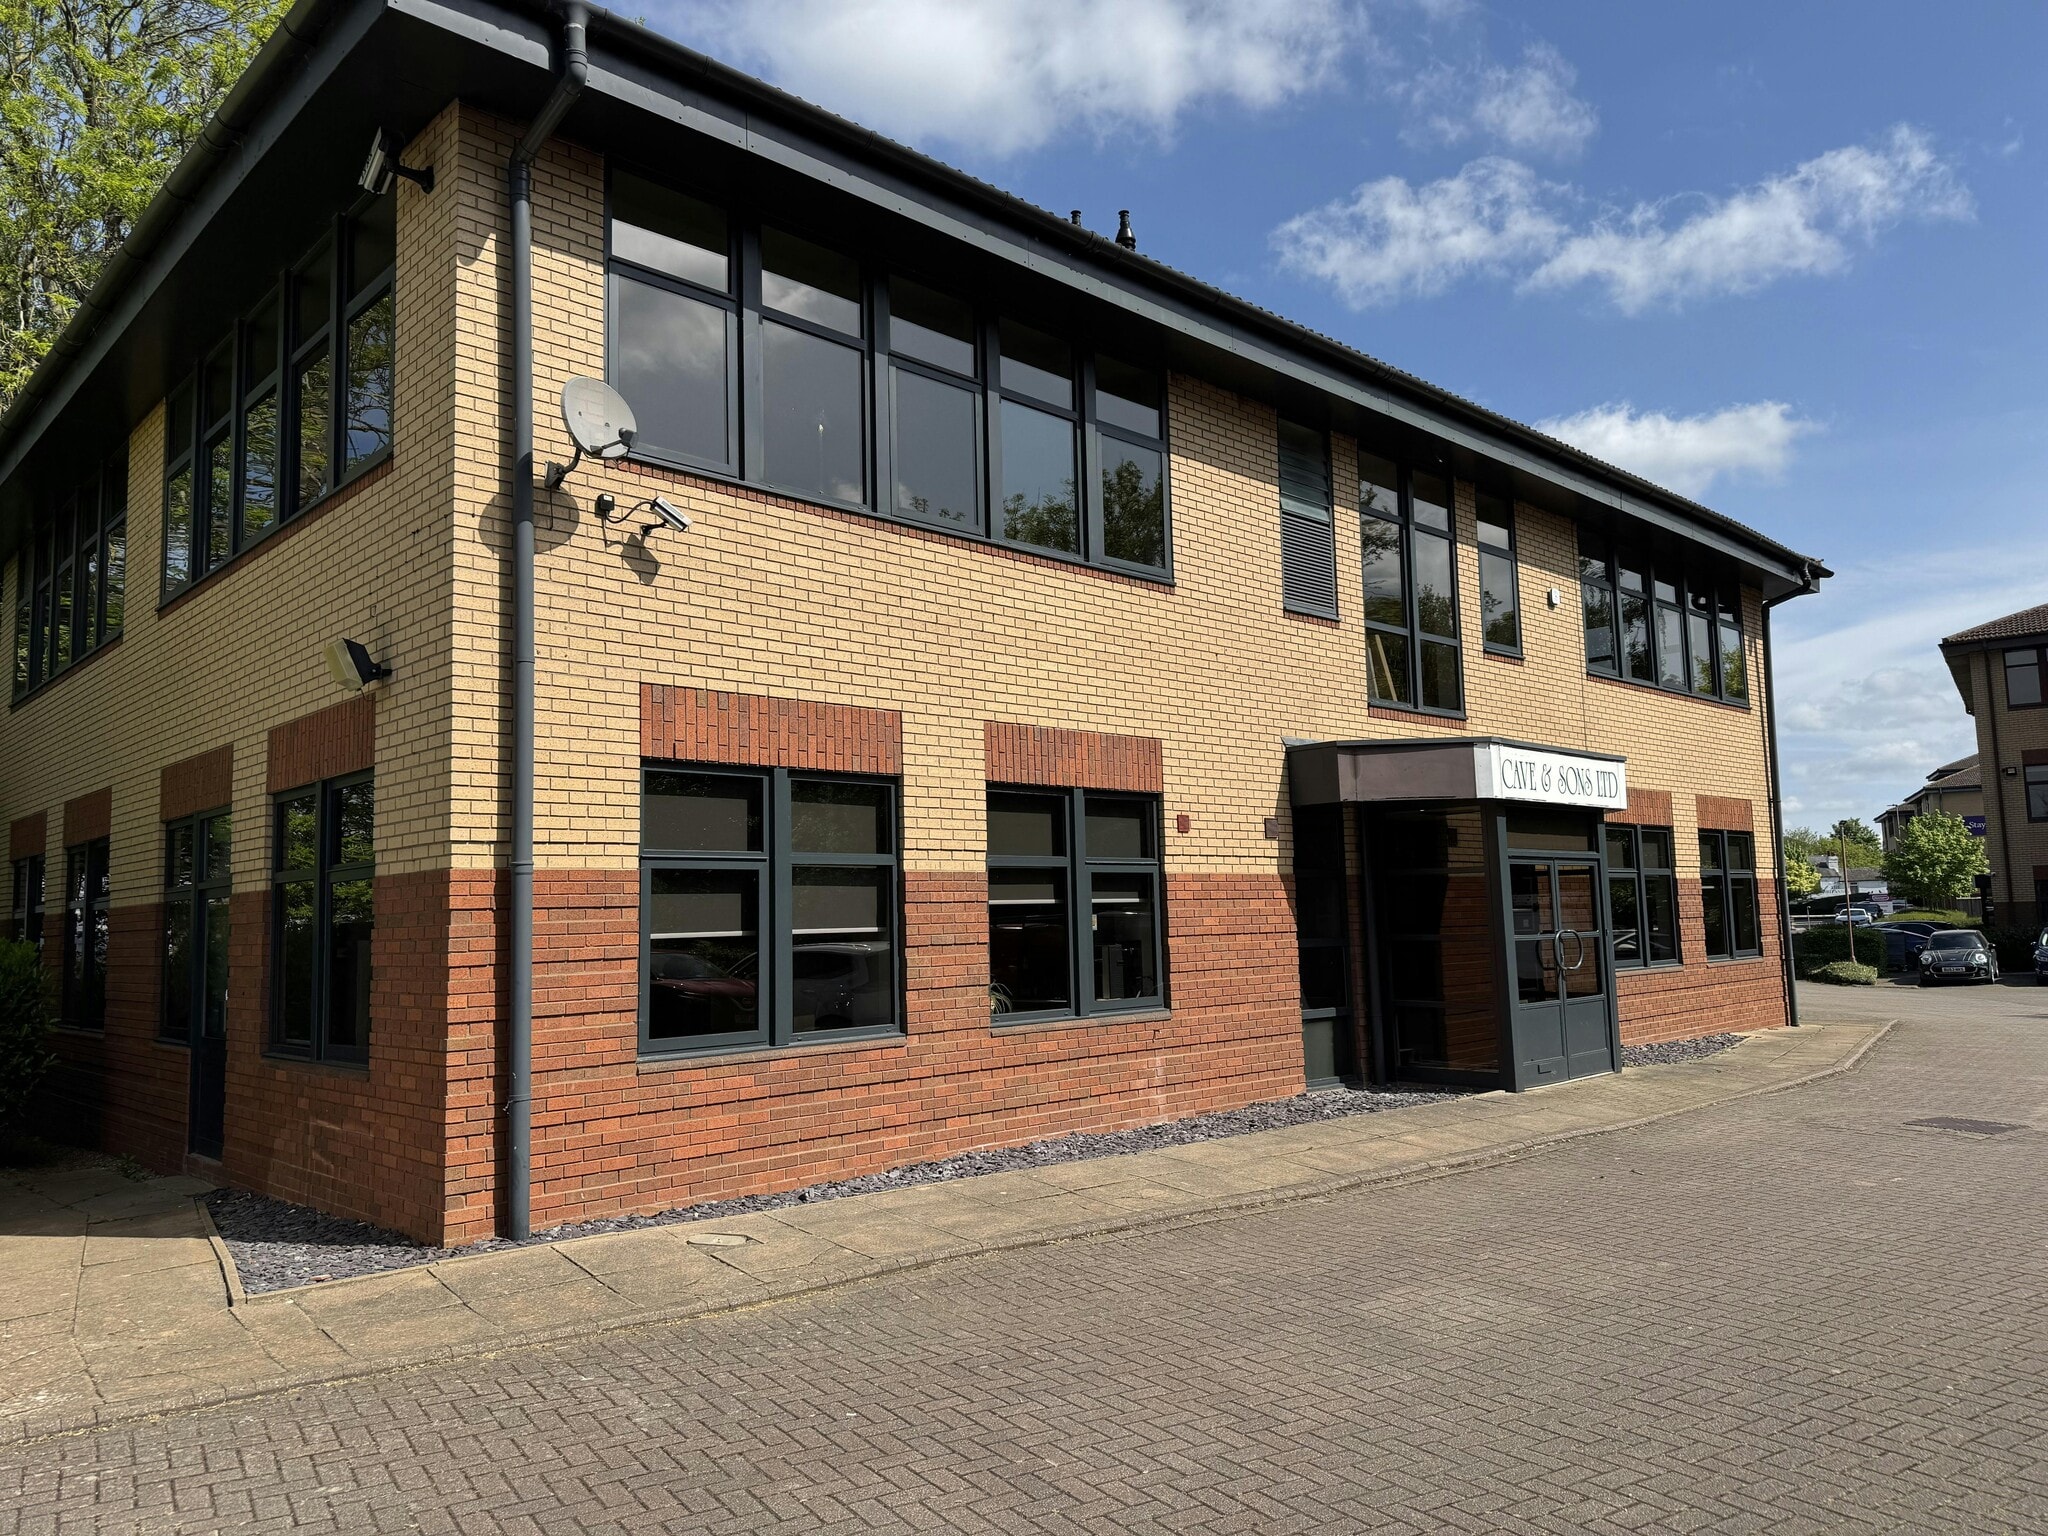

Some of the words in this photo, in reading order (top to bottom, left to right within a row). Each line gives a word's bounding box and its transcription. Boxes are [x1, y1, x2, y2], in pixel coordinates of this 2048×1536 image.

[1501, 758, 1537, 791] CAVE
[1541, 763, 1552, 793] &
[1557, 765, 1593, 797] SONS
[1596, 770, 1619, 799] LTD
